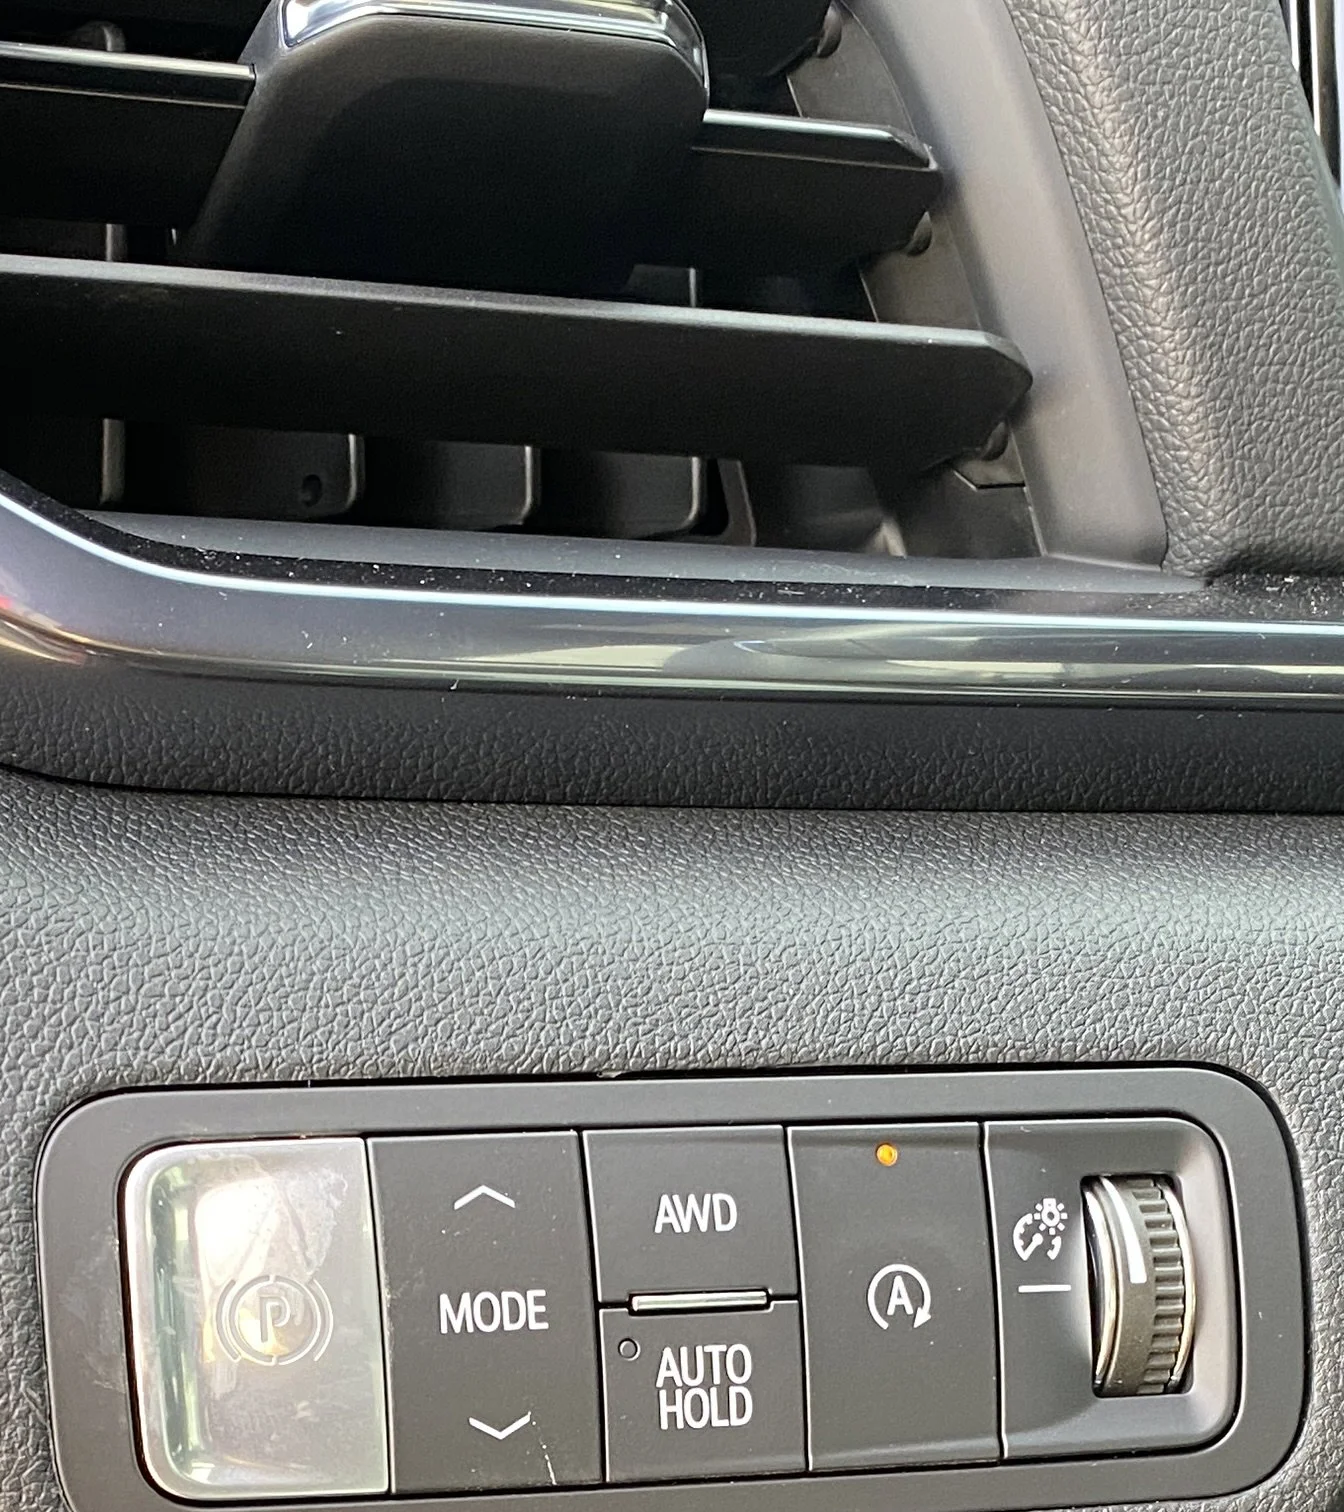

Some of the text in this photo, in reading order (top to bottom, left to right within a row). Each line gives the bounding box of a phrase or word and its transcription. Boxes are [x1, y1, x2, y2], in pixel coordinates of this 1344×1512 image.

[654, 1192, 738, 1233] AWD
[439, 1289, 549, 1334] MODE
[886, 1275, 914, 1316] A
[258, 1295, 291, 1343] P
[655, 1343, 753, 1387] AUTO
[659, 1386, 753, 1430] HOLD
